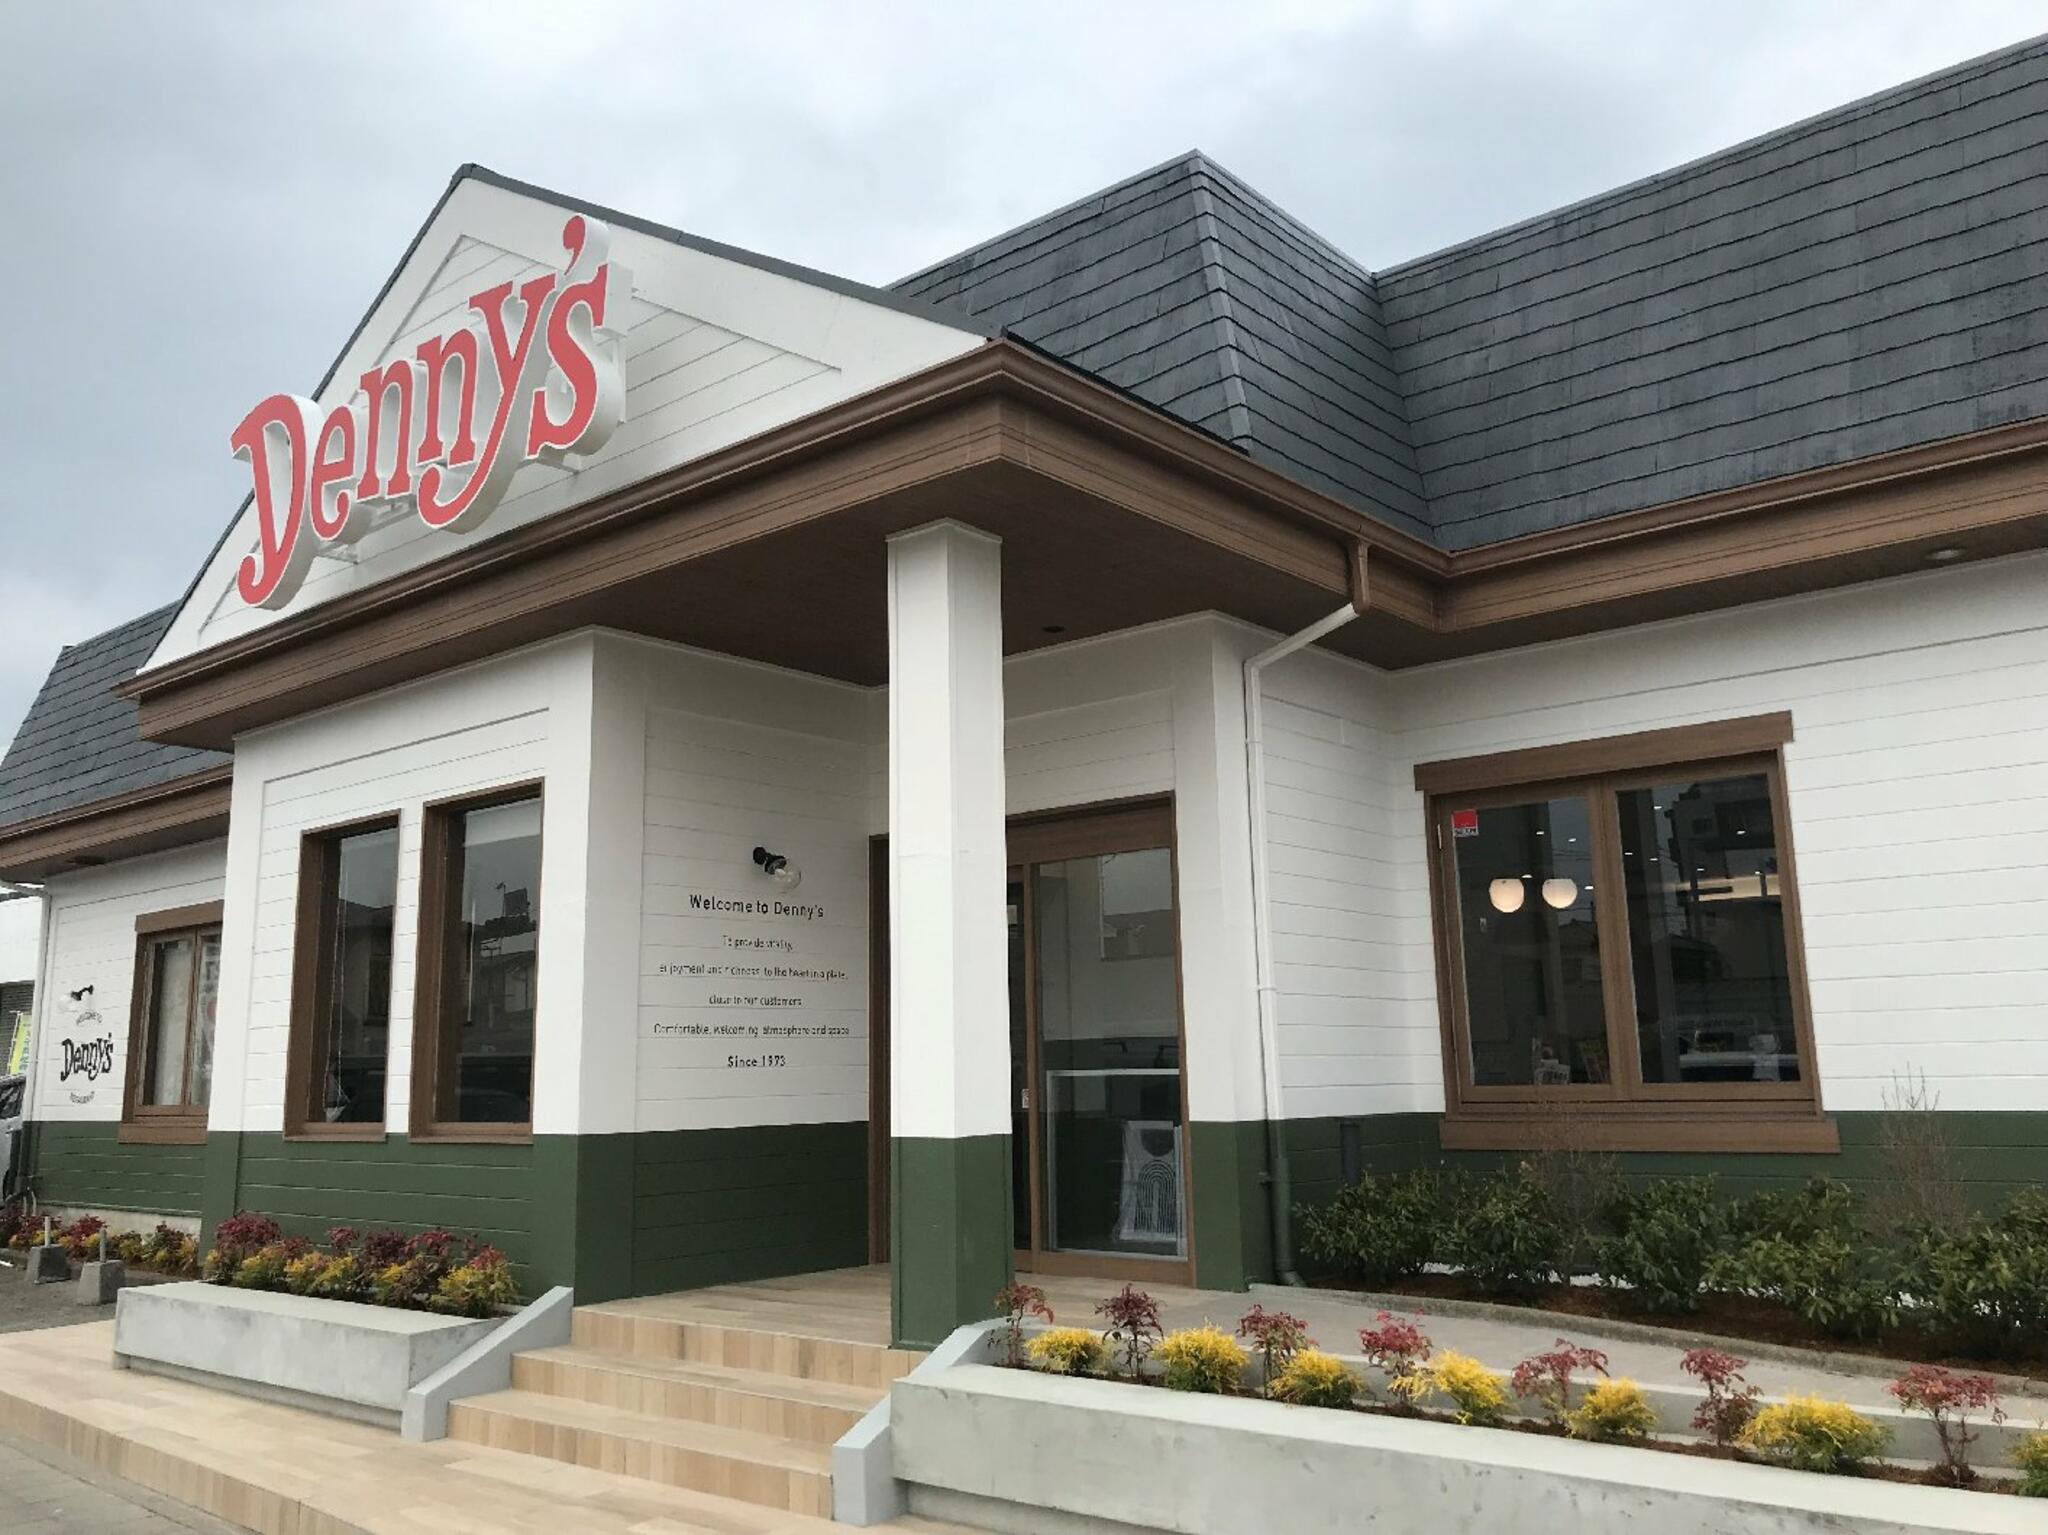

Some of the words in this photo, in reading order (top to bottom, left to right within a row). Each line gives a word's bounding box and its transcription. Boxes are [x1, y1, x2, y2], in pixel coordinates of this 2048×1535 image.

[230, 214, 609, 608] Denny's
[689, 894, 752, 913] Welcome
[756, 901, 769, 914] to
[774, 901, 824, 920] Denny's
[763, 967, 773, 976] to
[774, 966, 787, 977] the
[60, 1032, 114, 1082] Denny's
[727, 1055, 758, 1068] Since
[762, 1054, 786, 1067] 1973
